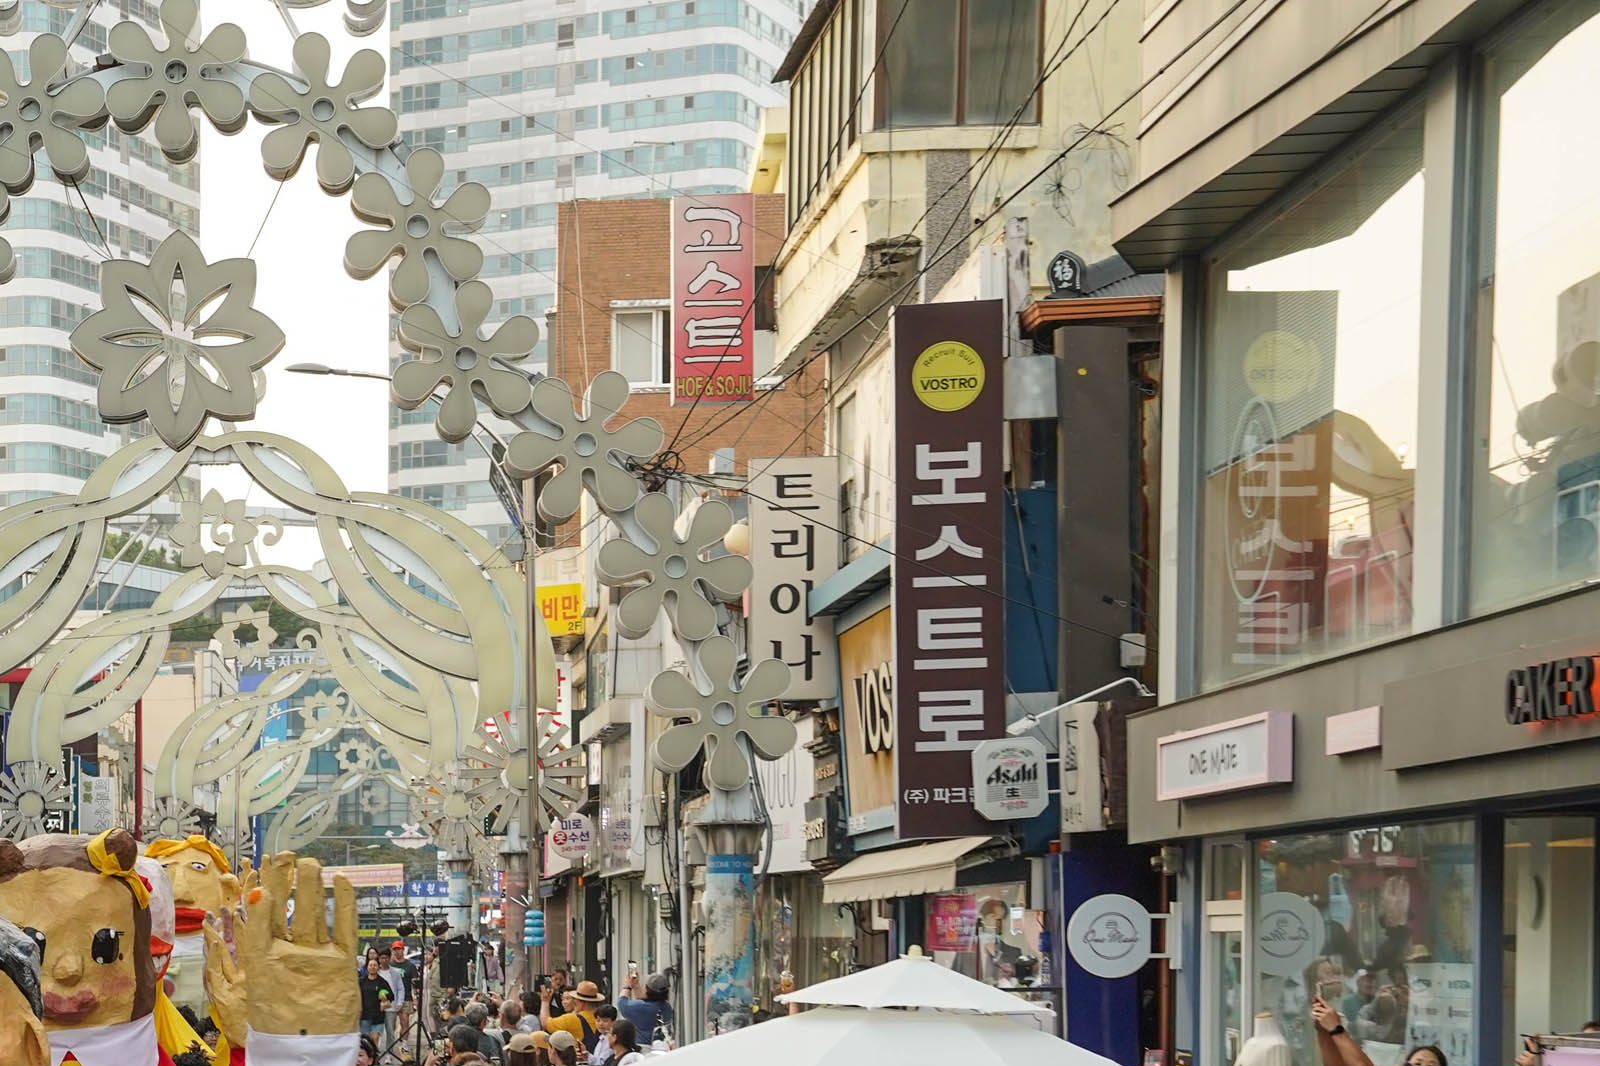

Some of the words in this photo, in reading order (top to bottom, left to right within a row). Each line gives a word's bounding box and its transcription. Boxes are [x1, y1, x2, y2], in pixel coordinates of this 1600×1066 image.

[683, 207, 743, 364] 고스트
[676, 376, 701, 398] HOF
[920, 377, 978, 390] VOSTRO
[911, 441, 988, 752] 보스트로
[541, 595, 580, 622] 비만
[568, 622, 582, 631] 2F
[853, 662, 894, 754] VOS
[987, 762, 1038, 785] Asahi
[903, 787, 930, 805] (주)
[1006, 787, 1021, 798] 生
[560, 820, 582, 830] 미로
[568, 831, 590, 842] 수선
